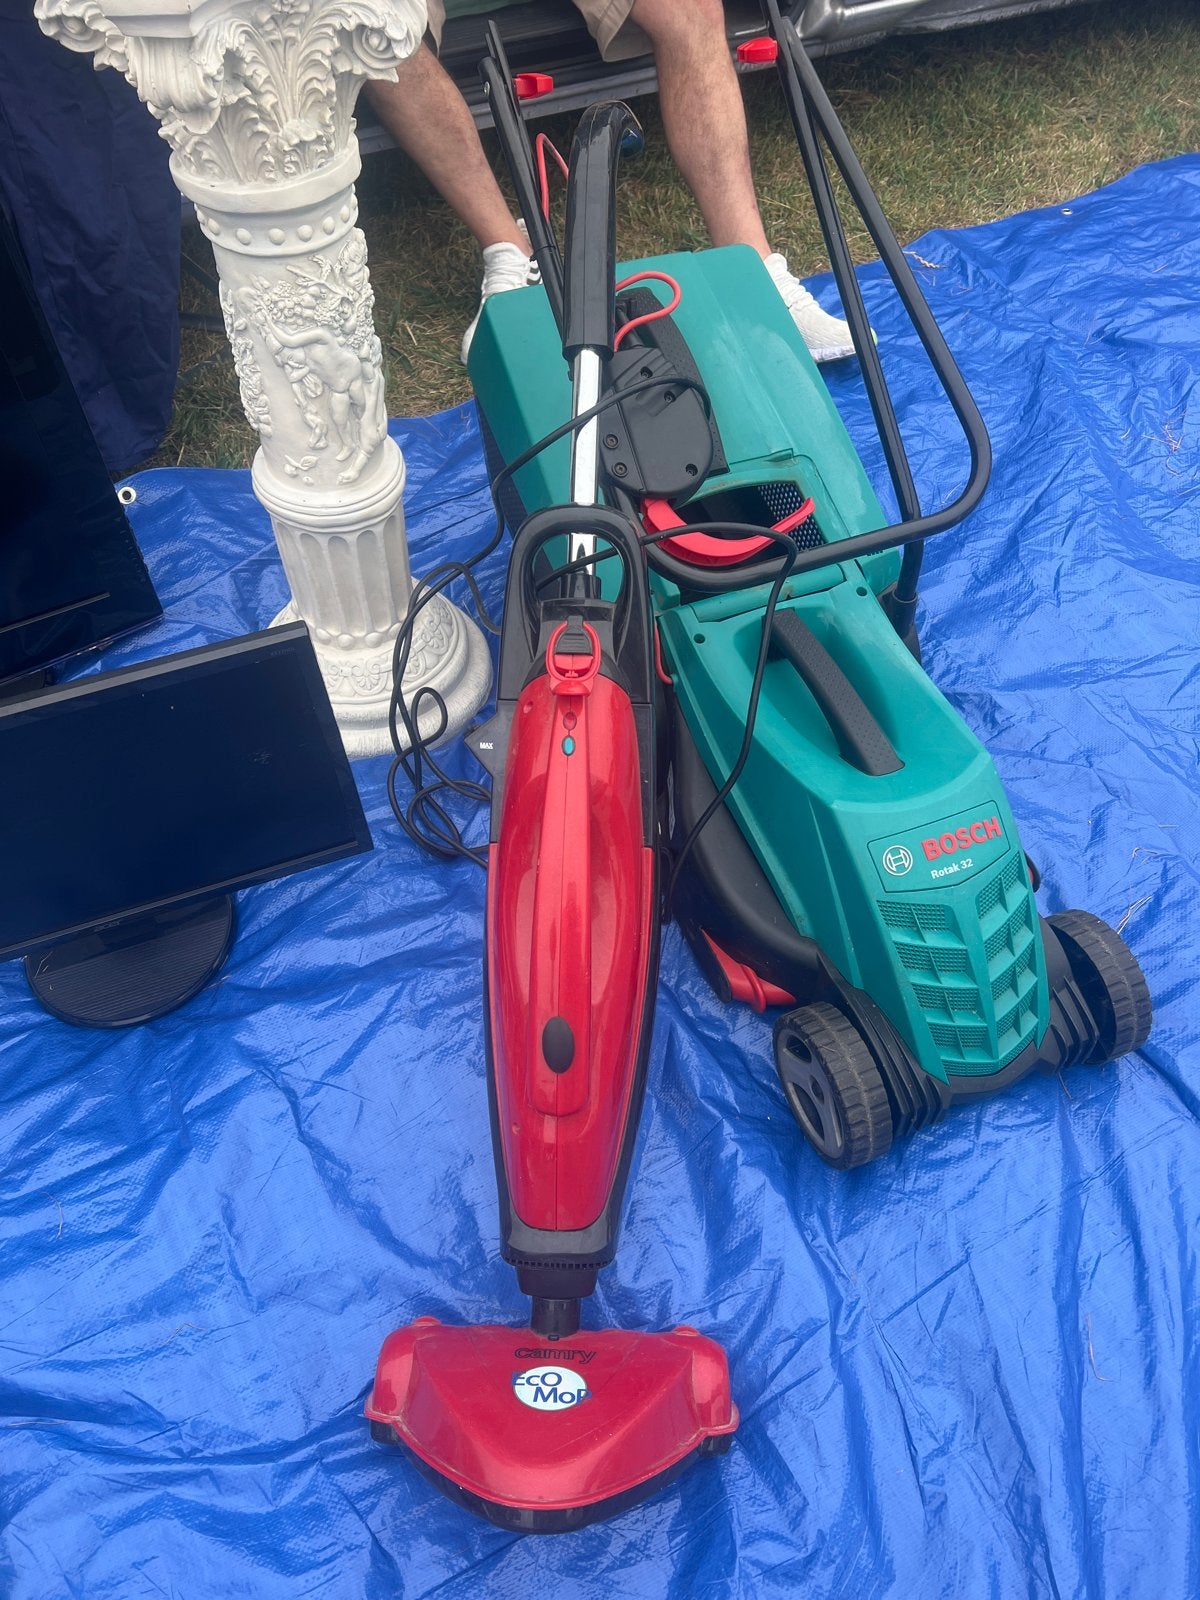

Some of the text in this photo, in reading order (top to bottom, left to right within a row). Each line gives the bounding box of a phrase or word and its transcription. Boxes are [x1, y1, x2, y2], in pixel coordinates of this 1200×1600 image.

[479, 742, 494, 750] MAX
[921, 816, 1002, 861] BOSCH
[930, 858, 974, 879] Rotak 32
